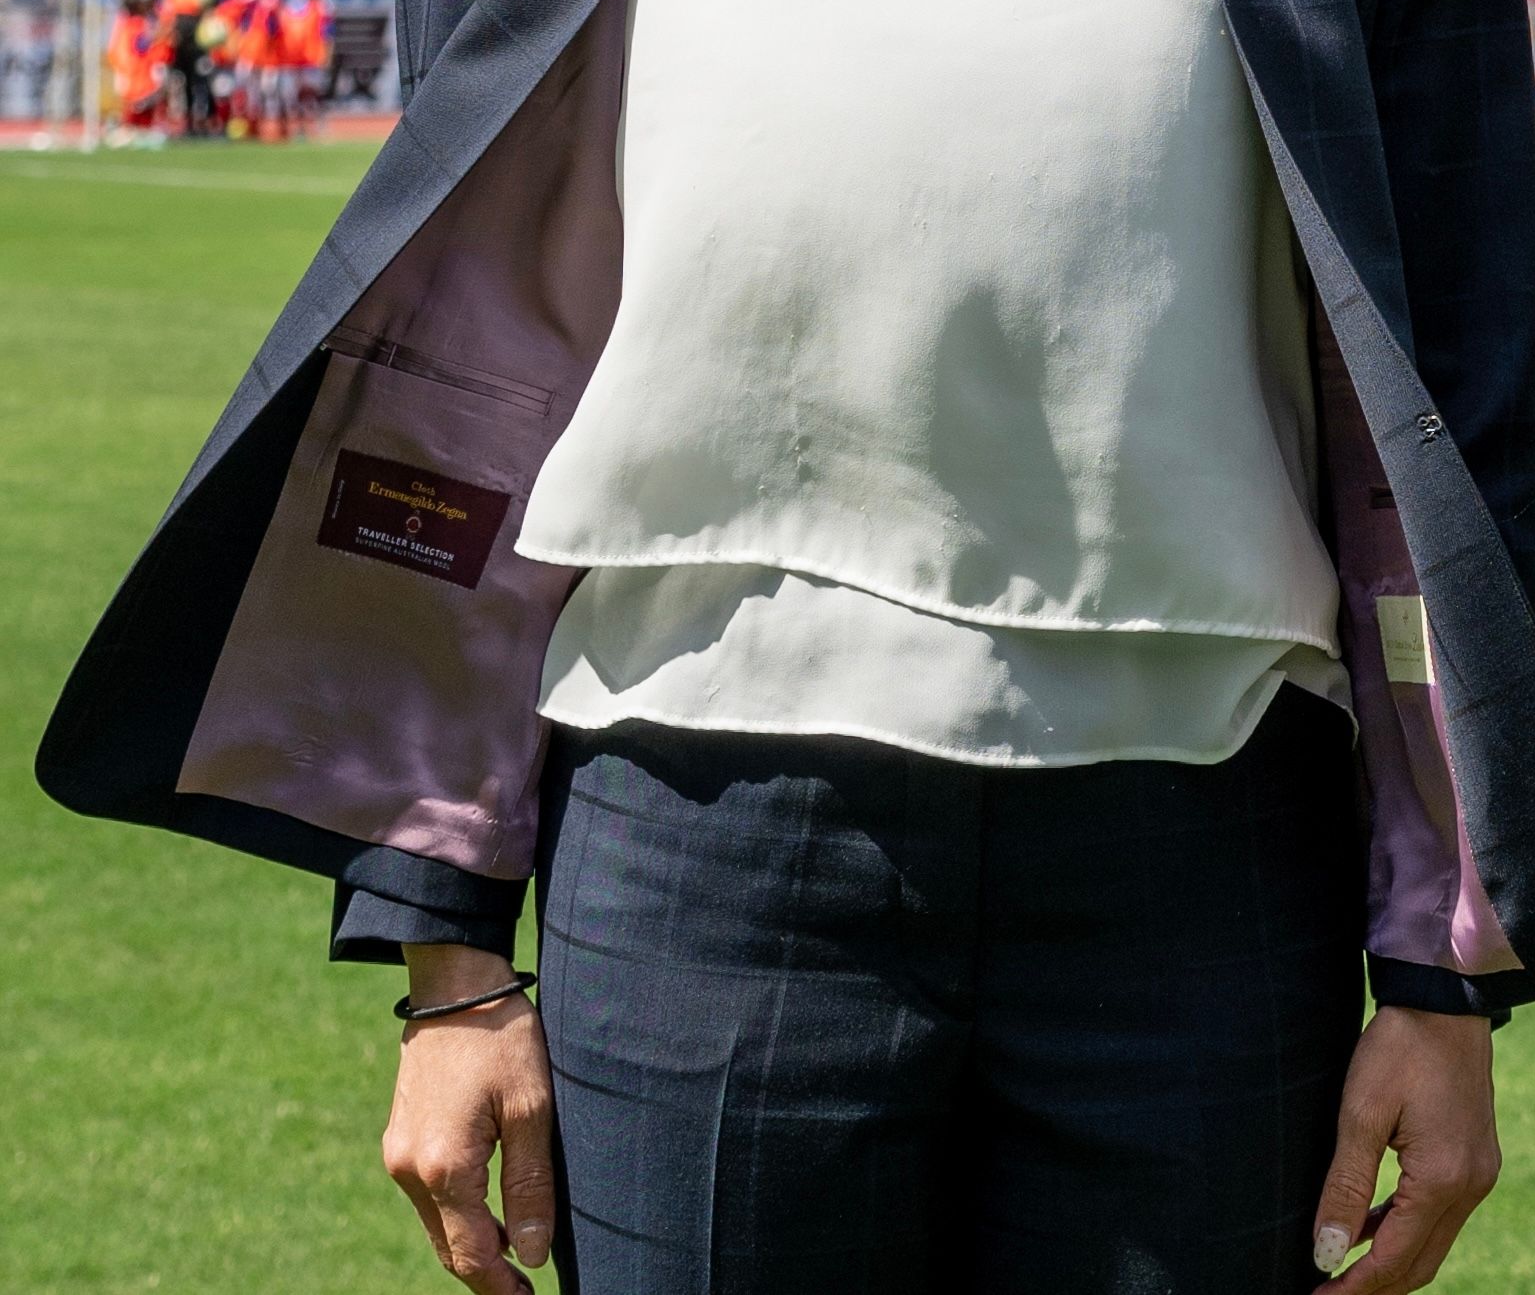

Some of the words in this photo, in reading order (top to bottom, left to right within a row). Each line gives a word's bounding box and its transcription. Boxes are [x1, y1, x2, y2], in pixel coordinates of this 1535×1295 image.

[367, 480, 436, 512] Ermenegildo
[435, 500, 468, 520] Zegna
[357, 526, 408, 548] TRAVELLER
[410, 541, 456, 562] SELECTION
